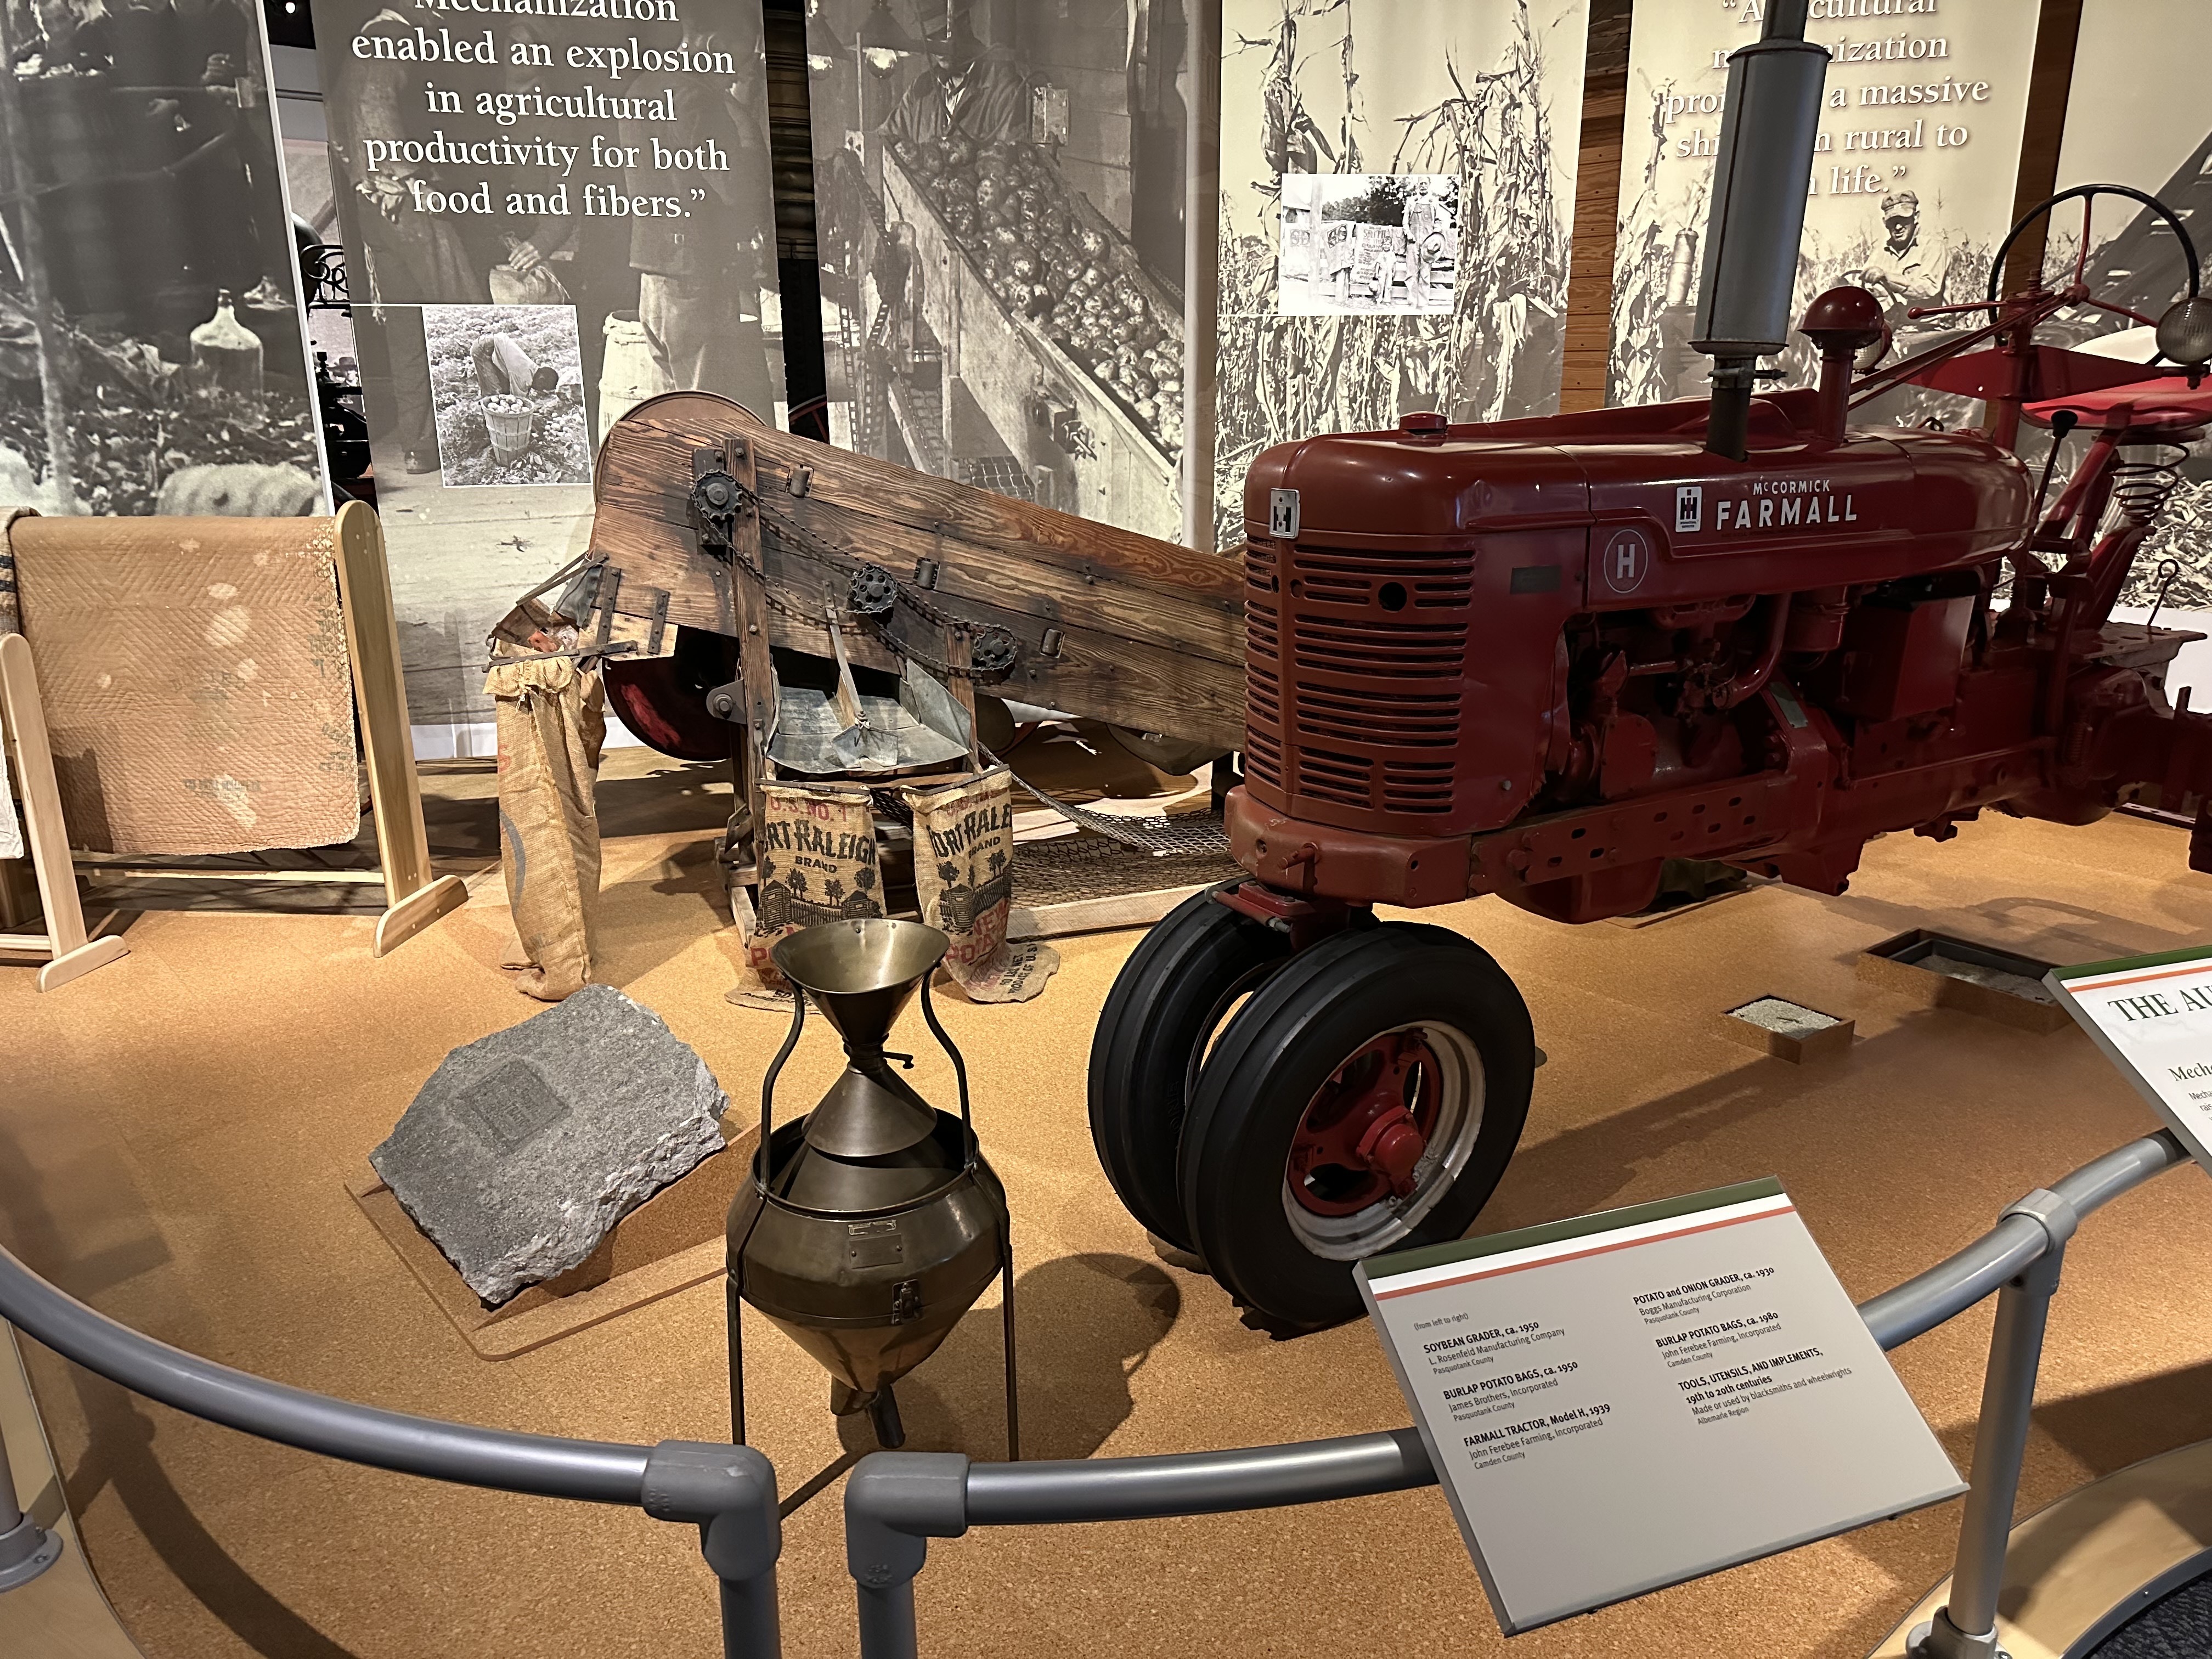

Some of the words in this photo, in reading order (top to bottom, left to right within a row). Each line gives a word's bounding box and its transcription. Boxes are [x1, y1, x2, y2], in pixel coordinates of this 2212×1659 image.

[352, 27, 498, 64] enabled
[510, 43, 555, 66] an
[567, 37, 736, 80] explosion
[425, 82, 464, 113] in
[476, 86, 678, 126] agricultural
[1829, 86, 1847, 108] a
[1859, 75, 1990, 106] massive
[1845, 120, 1924, 151] rural
[1937, 126, 1968, 146] to
[363, 131, 579, 176] productivity
[590, 135, 640, 168] for
[650, 138, 730, 171] both
[1829, 165, 1907, 195] life.”
[413, 180, 494, 214] food
[506, 184, 572, 216] and
[583, 183, 706, 218] fibers.”
[1717, 494, 1858, 530] FARMALL
[1617, 544, 1636, 579] H
[795, 855, 838, 873] BRAND
[2107, 994, 2179, 1022] THE
[2179, 985, 2212, 1011] AU
[2167, 1062, 2212, 1081] Mech
[1633, 1291, 1665, 1305] POTATO
[1666, 1287, 1681, 1297] and
[1681, 1281, 1709, 1294] ONION
[1708, 1273, 1743, 1287] GRADER,
[1756, 1267, 1774, 1277] 1930
[1639, 1305, 1662, 1316] Boggs
[1662, 1294, 1712, 1310] Manufacturing
[1712, 1284, 1752, 1299] Corporation
[1414, 1322, 1432, 1331] (from
[1432, 1318, 1443, 1326] left
[1451, 1312, 1469, 1322] right)
[1644, 1312, 1679, 1325] Pasquotank
[1679, 1307, 1700, 1316] County
[1655, 1333, 1688, 1347] BURLAP
[1688, 1325, 1720, 1339] POTATO
[1720, 1319, 1747, 1331] BAGS,
[1759, 1312, 1779, 1323] 1980
[1423, 1336, 1465, 1353] SOYBEAN
[1466, 1329, 1504, 1344] GRADER,
[1519, 1322, 1539, 1333] 1950
[1437, 1347, 1476, 1363] Rosenfeld
[1476, 1336, 1531, 1354] Manufacturing
[1531, 1328, 1565, 1341] Company
[1661, 1350, 1680, 1360] John
[1679, 1341, 1708, 1355] Ferebee
[1707, 1334, 1739, 1347] Farming,
[1737, 1322, 1782, 1340] Incorporated
[1433, 1361, 1472, 1374] Pasquotank
[1471, 1356, 1494, 1365] County
[1667, 1357, 1692, 1368] Camden
[1692, 1352, 1713, 1362] County
[1678, 1376, 1711, 1391] TOOLS,
[1709, 1365, 1752, 1383] UTENSILS,
[1752, 1361, 1769, 1373] AND
[1768, 1347, 1824, 1368] IMPLEMENTS,
[1443, 1384, 1479, 1400] BURLAP
[1480, 1375, 1514, 1391] POTATO
[1515, 1369, 1543, 1383] BAGS,
[1544, 1367, 1557, 1375] ca.
[1558, 1362, 1578, 1373] 1950
[1448, 1400, 1474, 1413] James
[1474, 1392, 1510, 1406] Brothers,
[1510, 1378, 1559, 1397] Incorporated
[1686, 1392, 1705, 1404] 19th
[1705, 1390, 1714, 1399] to
[1715, 1384, 1735, 1396] 20th
[1736, 1376, 1773, 1391] centuries
[1691, 1403, 1713, 1415] Made
[1722, 1396, 1740, 1407] used
[1740, 1394, 1750, 1403] by
[1750, 1383, 1793, 1400] blacksmiths
[1793, 1378, 1807, 1389] and
[1807, 1367, 1852, 1385] wheelwrights
[1453, 1407, 1492, 1421] Pasquotank
[1492, 1402, 1515, 1412] County
[1463, 1429, 1506, 1447] FARMALL
[1504, 1418, 1550, 1436] TRACTOR,
[1549, 1410, 1578, 1425] Model
[1577, 1408, 1589, 1418] H,
[1589, 1403, 1610, 1415] 1939
[1697, 1412, 1728, 1425] Albemarle
[1728, 1407, 1750, 1417] Region
[1469, 1448, 1488, 1460] John
[1488, 1440, 1520, 1454] Ferebee
[1520, 1432, 1555, 1446] Farming,
[1555, 1417, 1604, 1437] Incorporated
[1474, 1457, 1502, 1470] Camden
[1502, 1451, 1526, 1462] County
